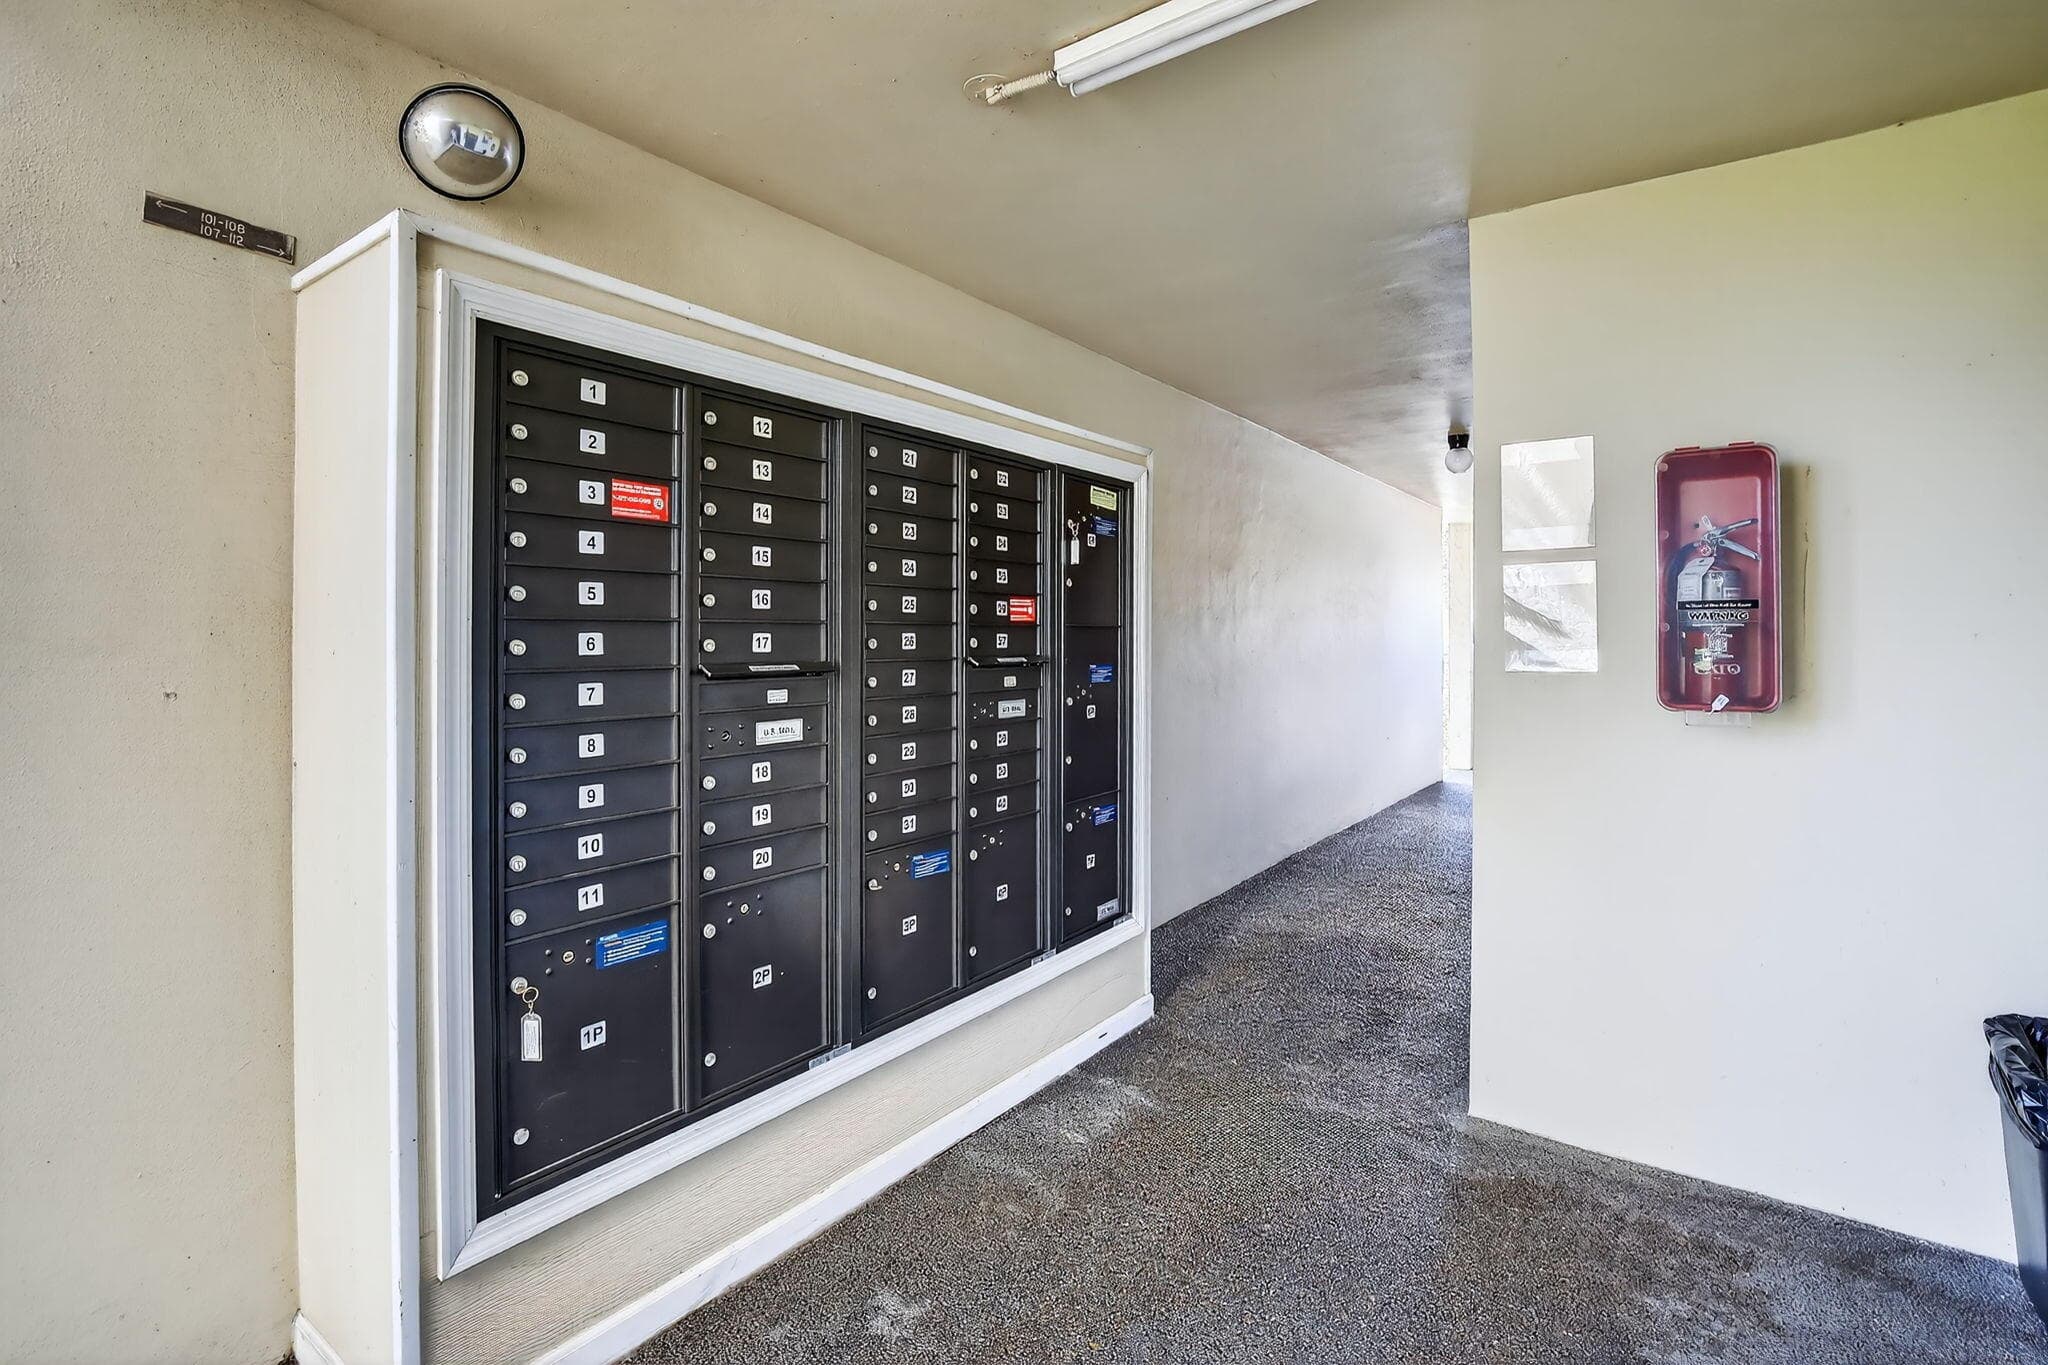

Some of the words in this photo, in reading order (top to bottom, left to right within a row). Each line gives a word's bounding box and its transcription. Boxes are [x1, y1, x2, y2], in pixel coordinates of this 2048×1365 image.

[201, 212, 245, 234] 101-108
[200, 223, 244, 247] 107-112
[755, 420, 770, 435] 12
[904, 452, 915, 466] 21
[756, 463, 770, 478] 13
[904, 489, 915, 502] 22
[755, 506, 769, 521] 14
[904, 525, 915, 538] 23
[755, 550, 769, 563] 15
[904, 562, 915, 574] 24
[754, 592, 769, 606] 16
[903, 599, 915, 611] 25
[755, 636, 769, 649] 17
[903, 635, 915, 648] 26
[903, 672, 915, 684] 27
[755, 765, 769, 779] 18
[756, 808, 769, 822] 19
[903, 817, 914, 831] 31
[581, 838, 600, 855] 10
[755, 851, 770, 865] 20
[581, 888, 599, 905] 11
[904, 918, 915, 932] 3P
[754, 968, 770, 985] 2P
[583, 1025, 604, 1044] 1P
